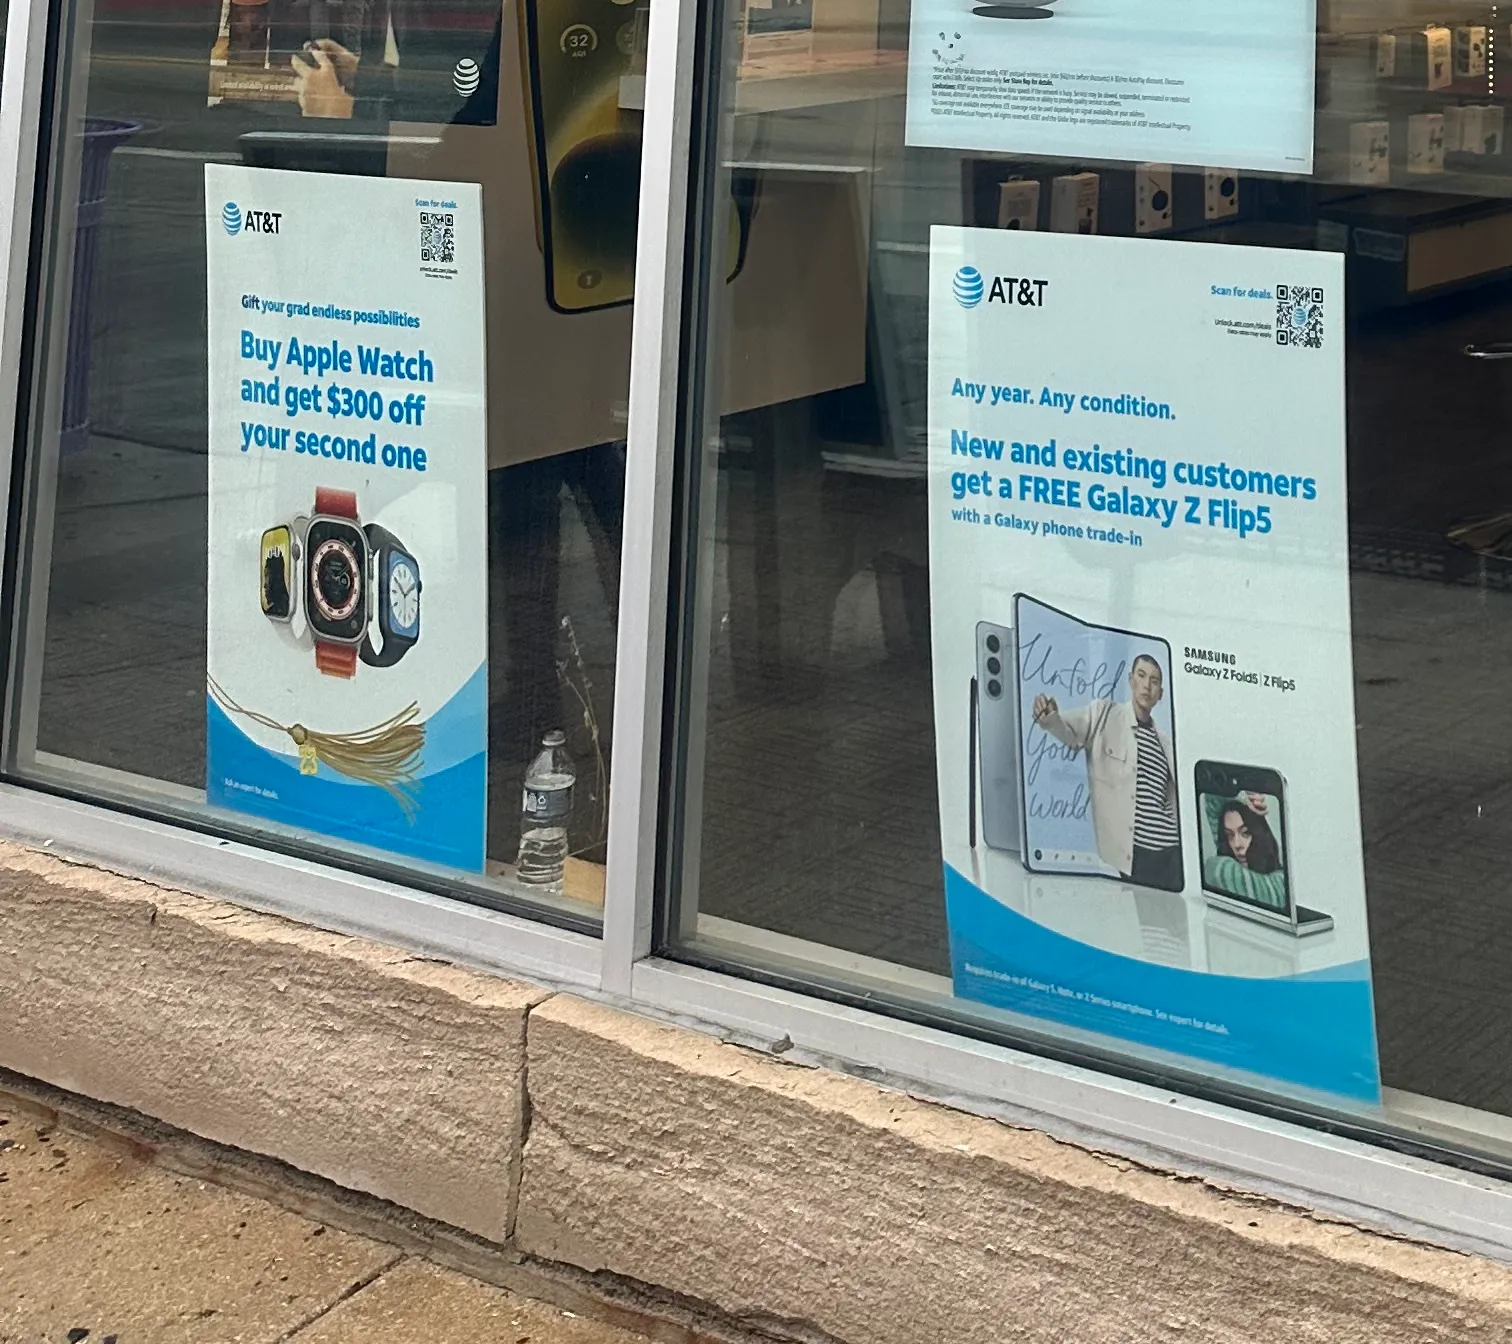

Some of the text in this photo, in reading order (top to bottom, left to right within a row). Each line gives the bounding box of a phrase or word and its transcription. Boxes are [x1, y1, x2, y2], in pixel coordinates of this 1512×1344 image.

[569, 34, 589, 48] 32
[244, 210, 282, 235] AT&T
[241, 294, 421, 329] Gift your grad endless possibilities
[988, 276, 1048, 307] AT&T
[1210, 285, 1274, 300] Scan for deals.
[240, 329, 434, 383] Buy Apple Watch
[241, 376, 427, 427] and get $300 off
[951, 377, 1176, 421] Any year. Any condition.
[240, 419, 428, 473] your second one
[951, 429, 1317, 501] New and existing customers
[951, 469, 1273, 539] get a FREE Galaxy Z Flip5
[951, 507, 1143, 548] with a Galaxy phone trade-in
[1019, 633, 1127, 703] Unfold
[1184, 646, 1236, 665] SAMSUNG
[1184, 661, 1222, 680] Galaxy
[1221, 668, 1230, 680] Z
[1263, 674, 1271, 687] Z
[1271, 675, 1296, 692] Flip5
